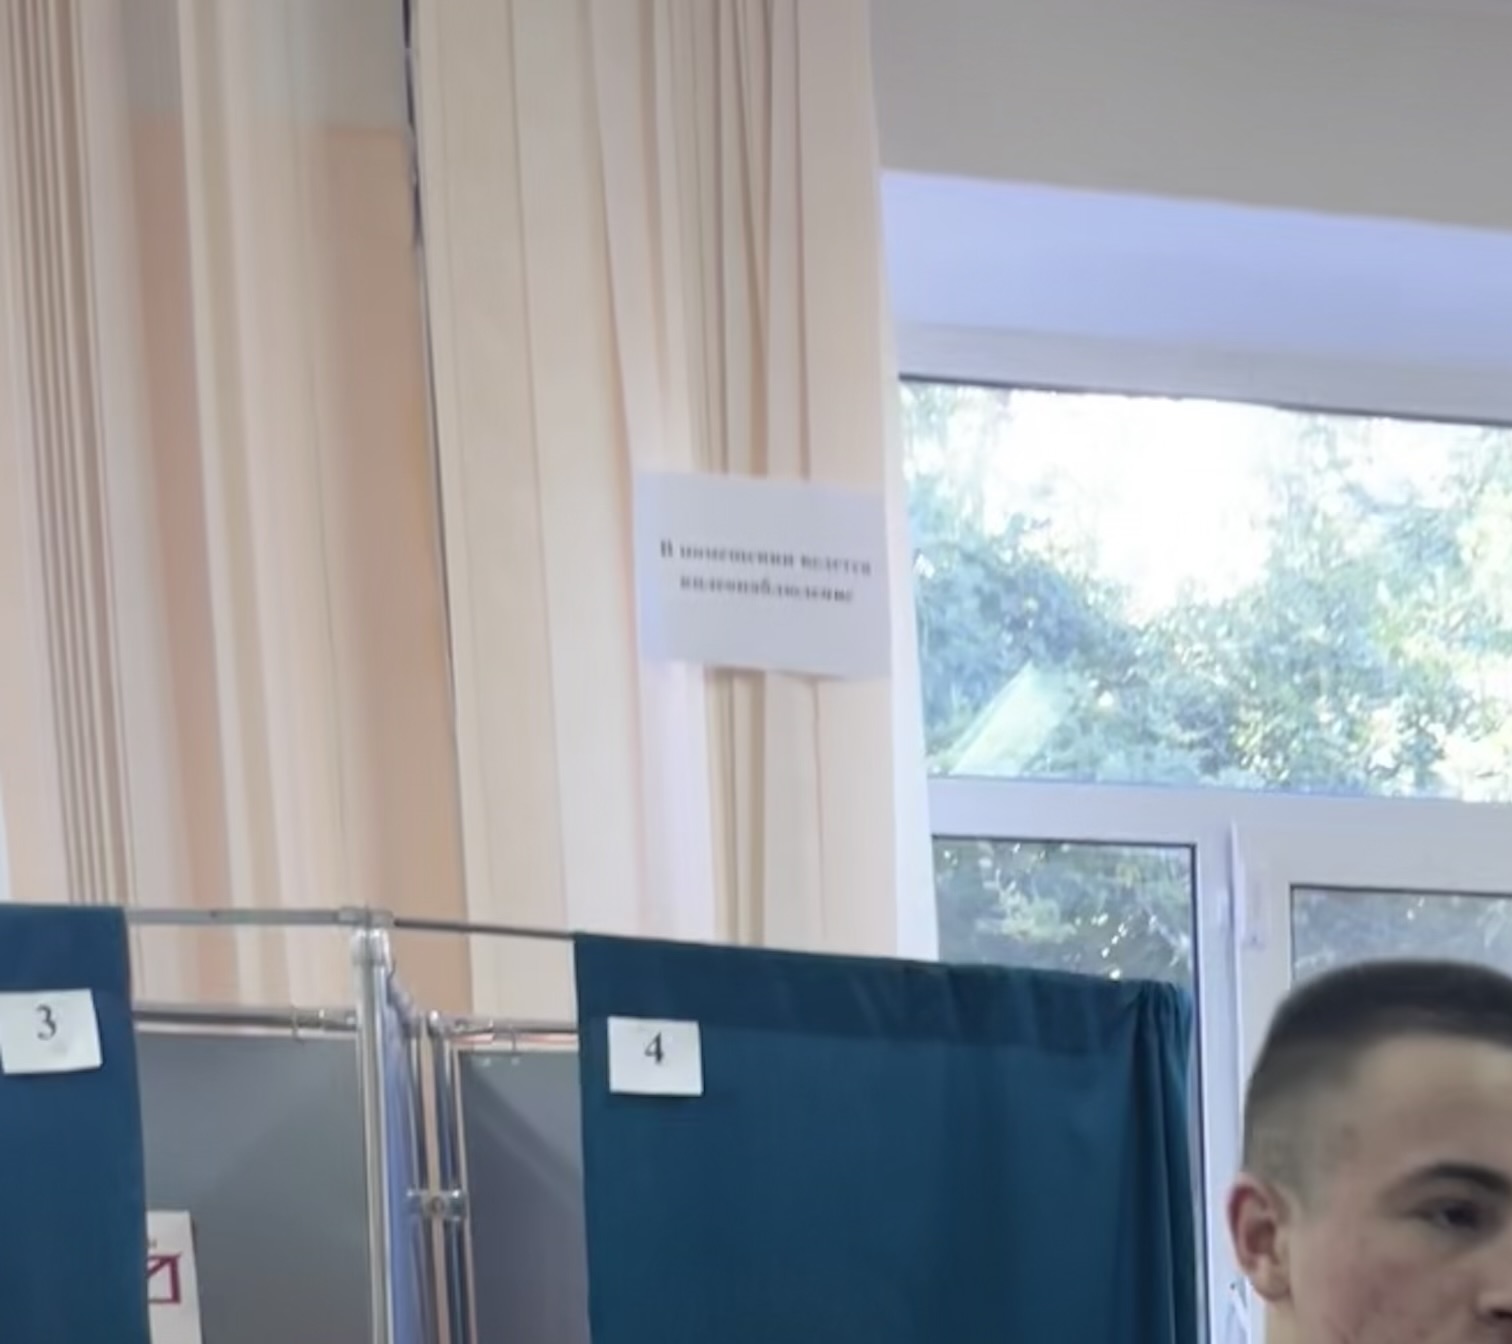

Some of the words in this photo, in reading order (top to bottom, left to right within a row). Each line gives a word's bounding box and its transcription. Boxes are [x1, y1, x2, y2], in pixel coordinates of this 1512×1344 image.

[660, 539, 674, 558] В
[680, 544, 794, 568] помещении
[36, 1004, 57, 1041] 3
[643, 1031, 665, 1065] 4
